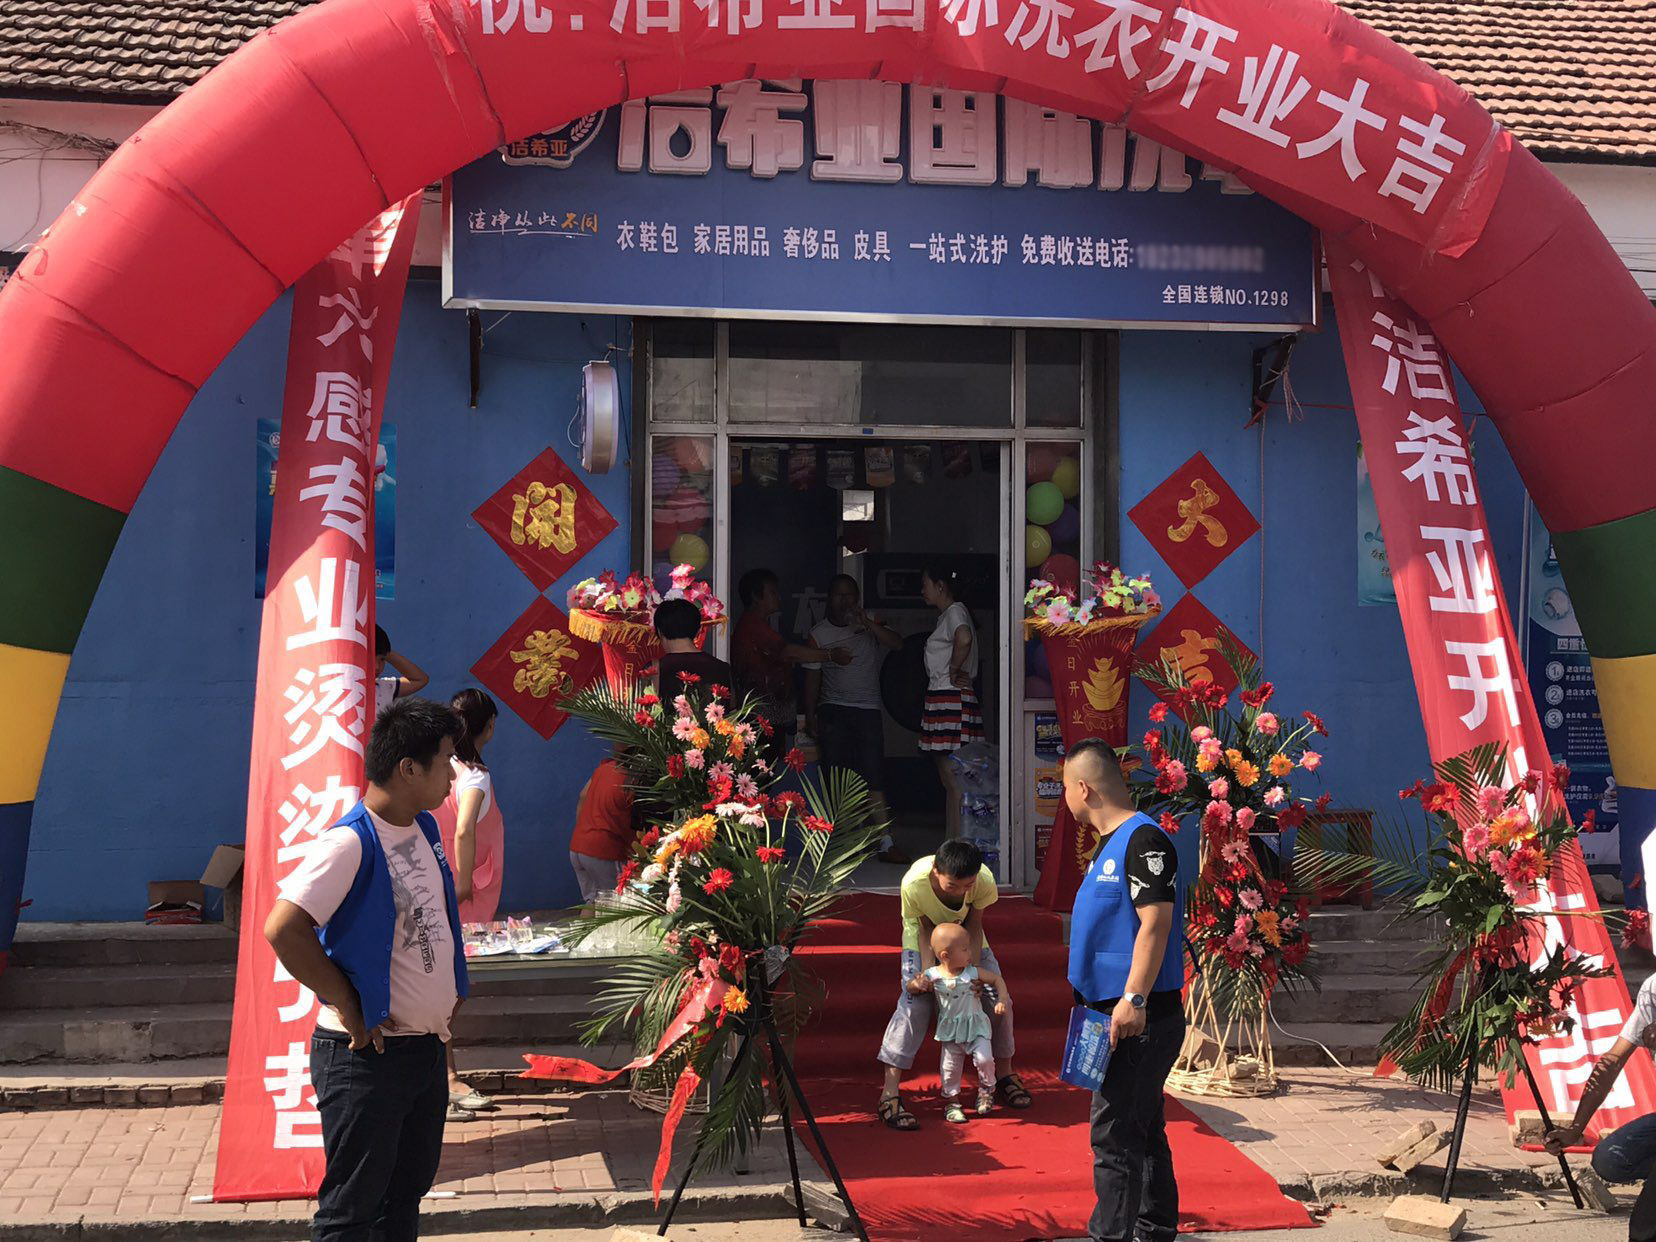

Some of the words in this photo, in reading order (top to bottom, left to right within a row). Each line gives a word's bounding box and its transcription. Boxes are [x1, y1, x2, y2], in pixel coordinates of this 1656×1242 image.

[468, 208, 599, 235] 洁净从此不同
[617, 221, 679, 254] 衣鞋包
[694, 225, 770, 257] 家居用品
[783, 227, 840, 260] 奢侈品
[853, 230, 892, 262] 皮具
[909, 233, 1009, 264] 一站式洗护
